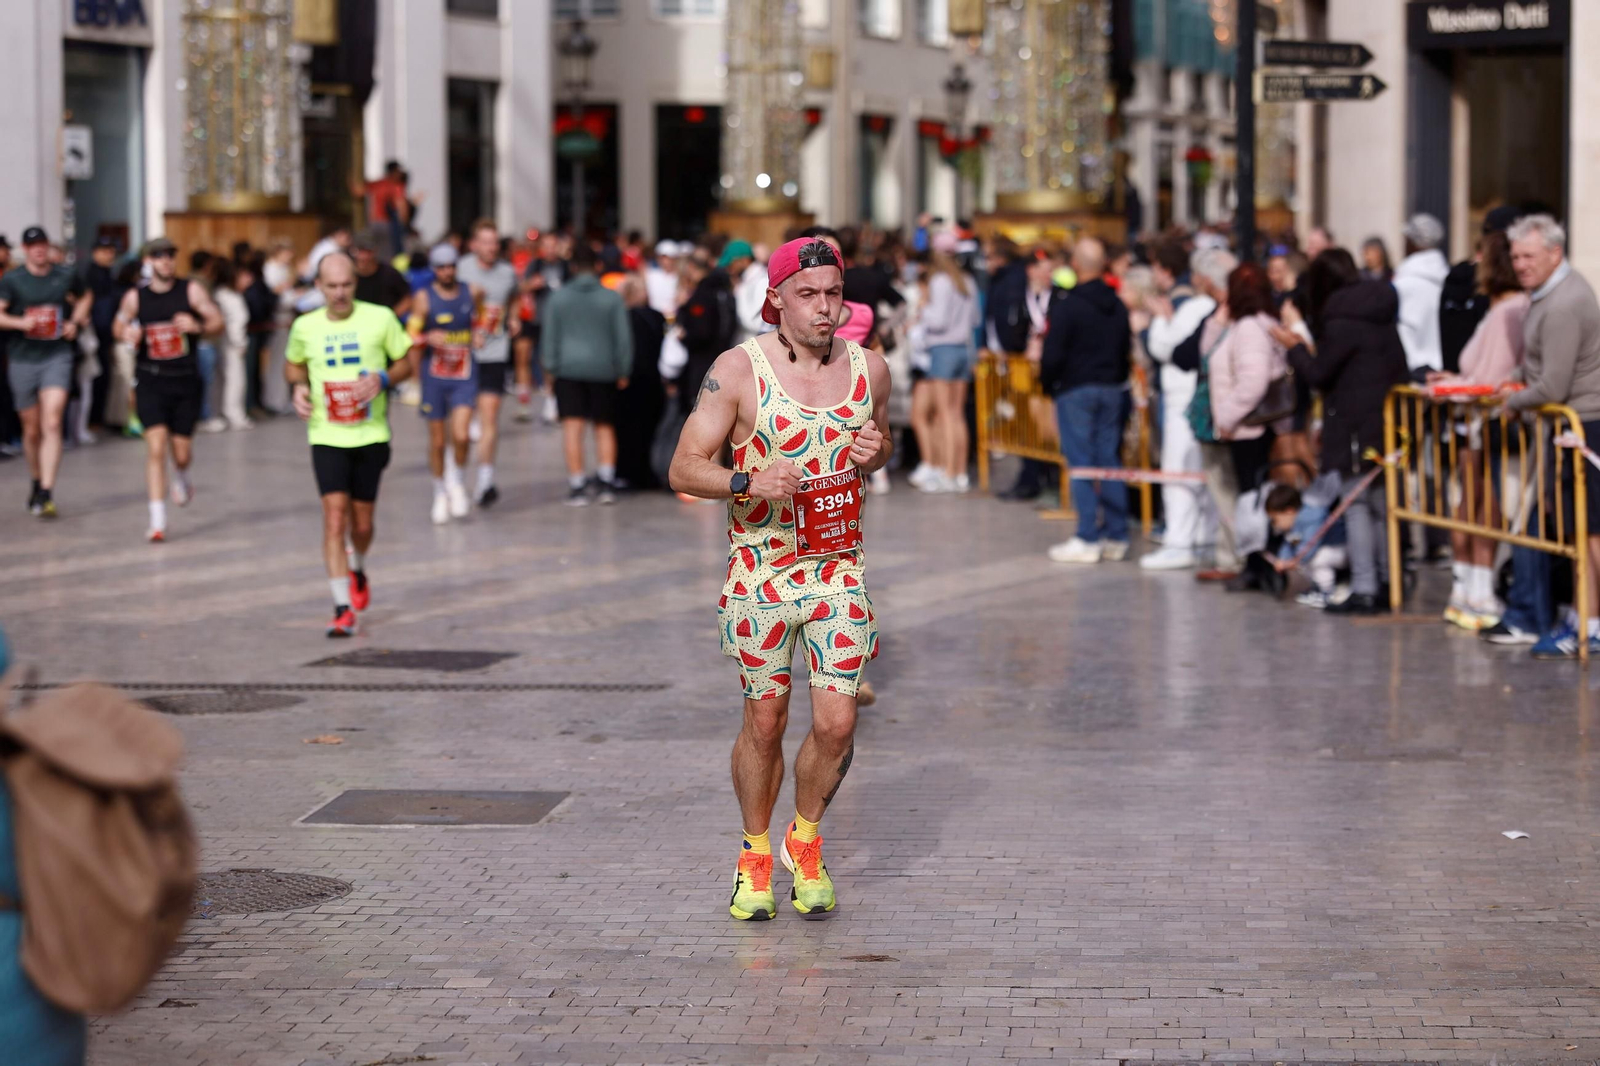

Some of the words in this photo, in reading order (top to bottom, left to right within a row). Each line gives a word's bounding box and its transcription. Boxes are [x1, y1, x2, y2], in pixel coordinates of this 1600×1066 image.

[1427, 5, 1502, 33] Massimo
[1503, 1, 1549, 29] Dutti
[814, 490, 854, 512] 3394
[827, 510, 843, 518] MATT
